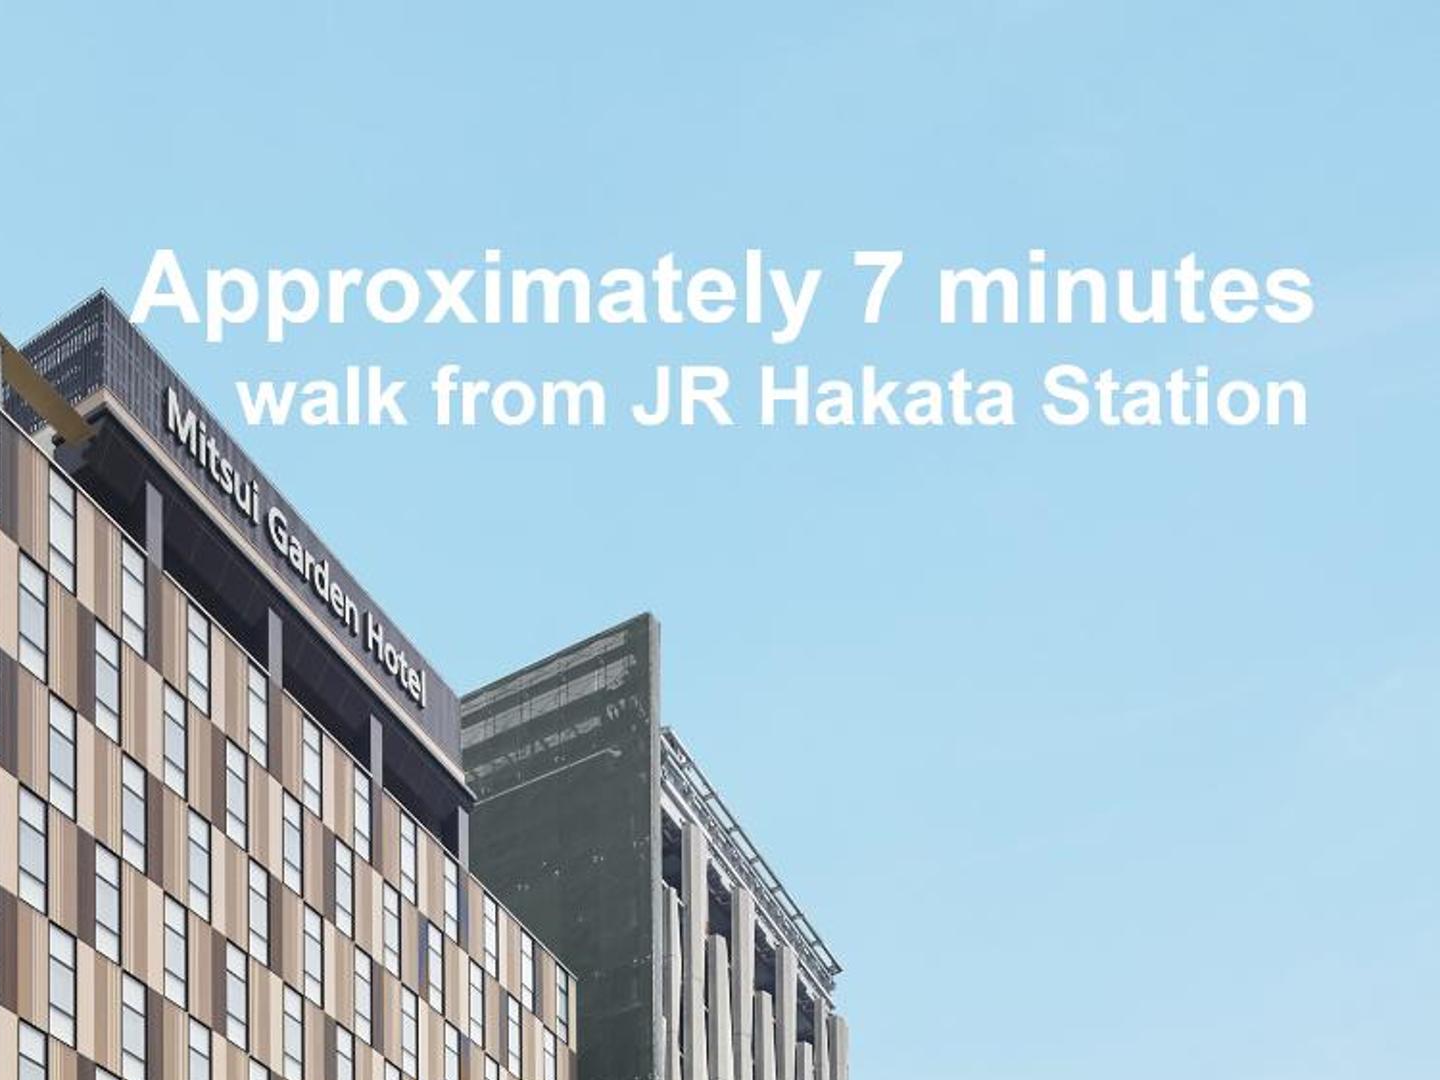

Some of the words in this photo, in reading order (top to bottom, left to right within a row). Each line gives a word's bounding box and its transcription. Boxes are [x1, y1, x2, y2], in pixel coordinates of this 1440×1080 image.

[167, 386, 260, 524] Mitsui
[268, 505, 359, 635] Garden
[366, 612, 426, 709] Hotel
